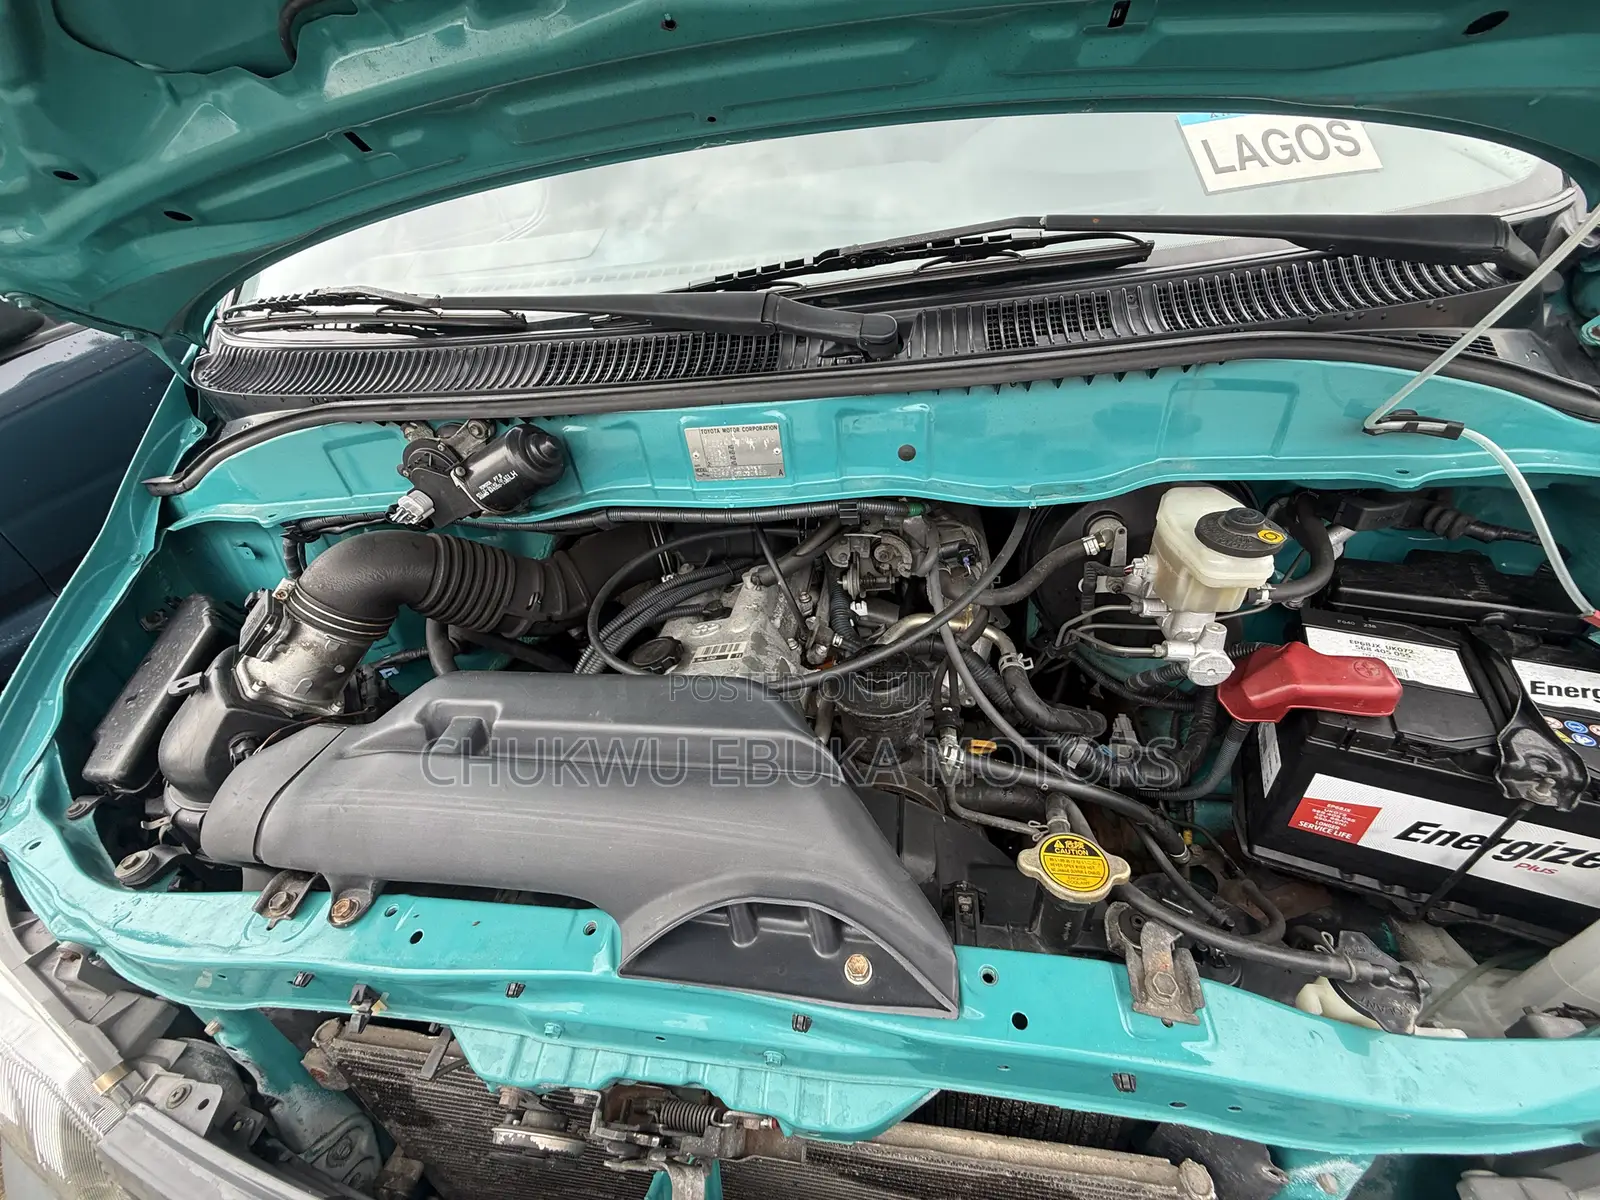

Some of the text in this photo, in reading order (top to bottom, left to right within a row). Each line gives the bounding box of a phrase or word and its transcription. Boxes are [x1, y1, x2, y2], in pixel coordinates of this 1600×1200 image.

[1201, 120, 1361, 174] LAGOS
[742, 425, 778, 433] CORPORATION
[1298, 821, 1353, 840] SERVICE LIFE
[1315, 820, 1340, 831] LONGER
[1054, 848, 1089, 856] CAUTION
[1513, 862, 1559, 876] plus
